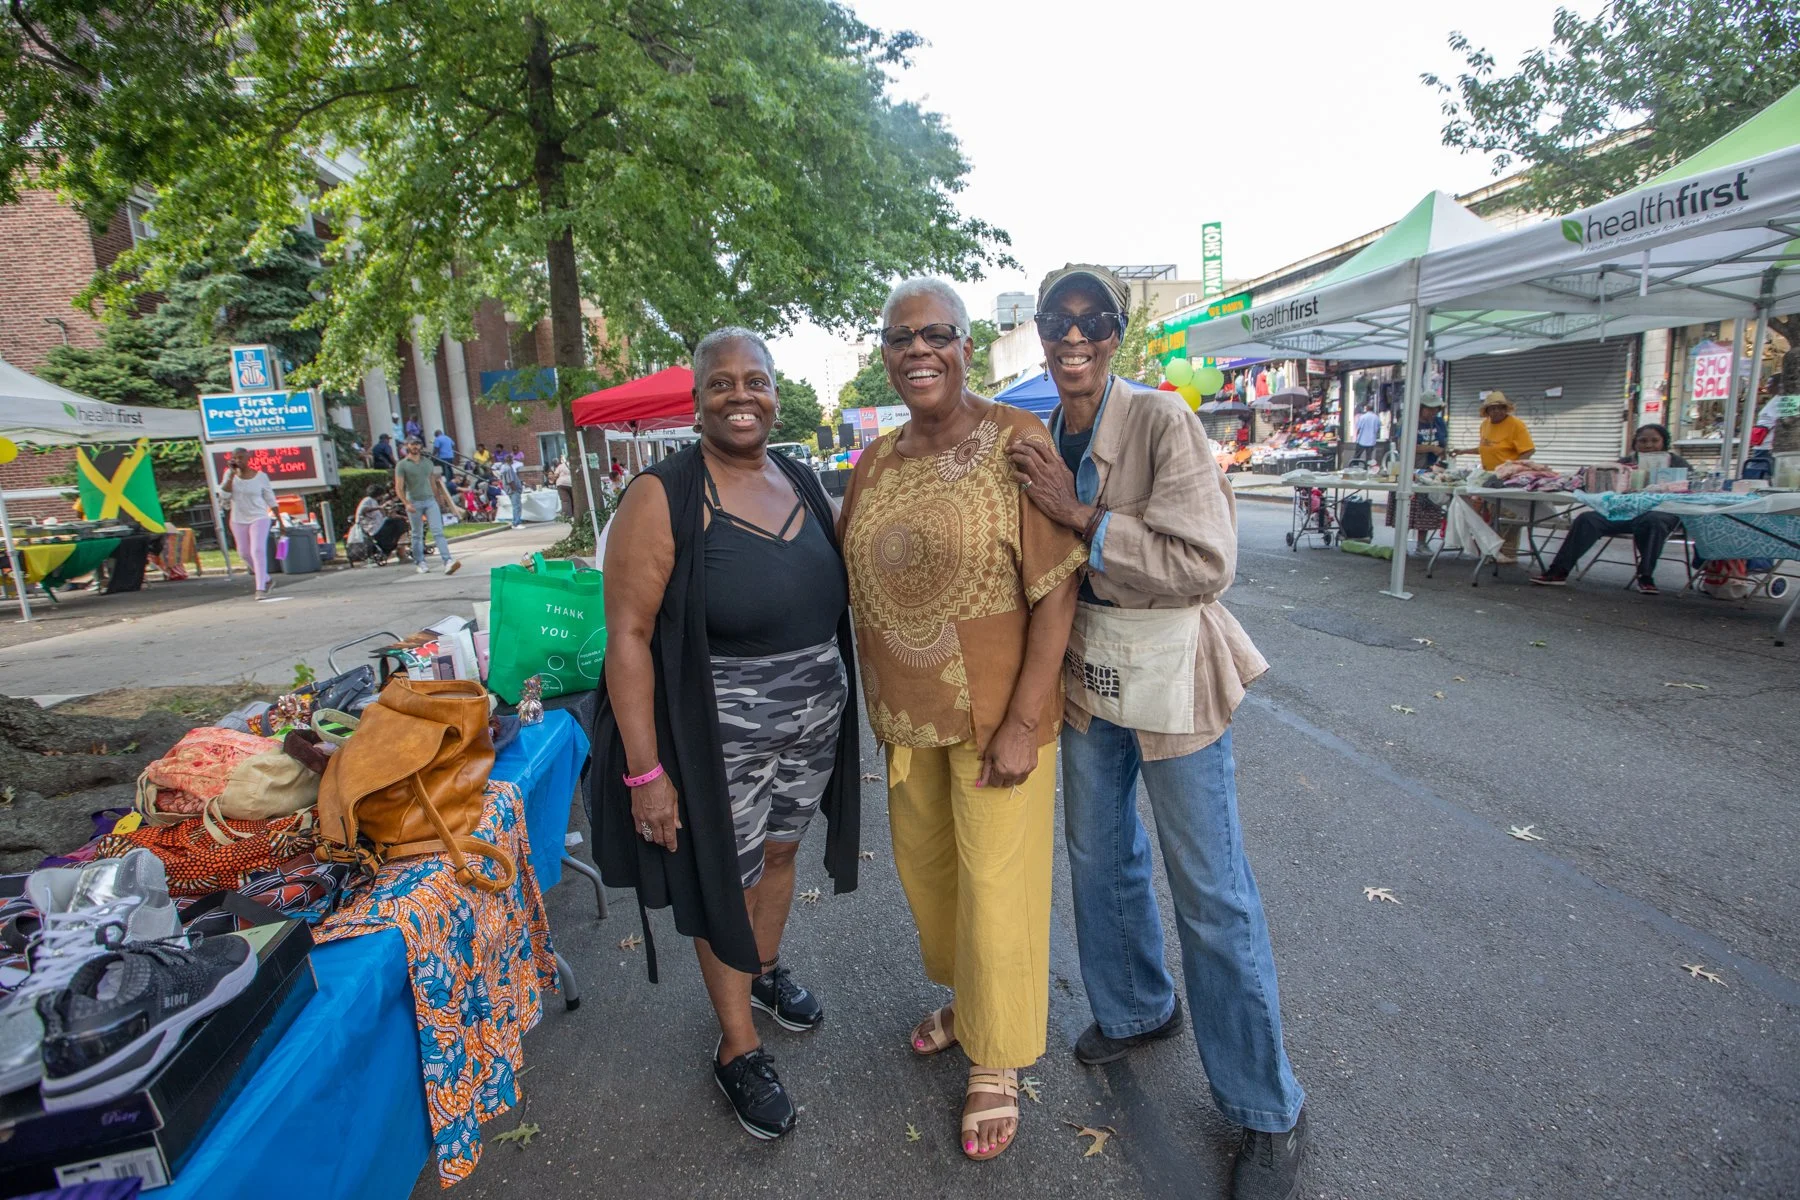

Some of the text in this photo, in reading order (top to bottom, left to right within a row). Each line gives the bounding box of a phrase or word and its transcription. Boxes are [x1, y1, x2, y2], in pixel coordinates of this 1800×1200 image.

[1586, 171, 1749, 243] healthfirst
[1585, 206, 1745, 252] Health Insurance for New Yorkers
[1204, 225, 1222, 295] PAWN SHOP
[1252, 295, 1319, 332] healthfirst
[1696, 355, 1732, 377] SHO
[238, 397, 275, 407] First
[77, 405, 144, 425] healthfirst
[208, 405, 308, 419] Presbyterian
[234, 416, 286, 427] Church
[250, 425, 287, 433] JAMAICA
[254, 447, 300, 458] US THIS
[280, 461, 306, 473] 10AM
[545, 603, 584, 620] THANK
[540, 625, 569, 639] YOU
